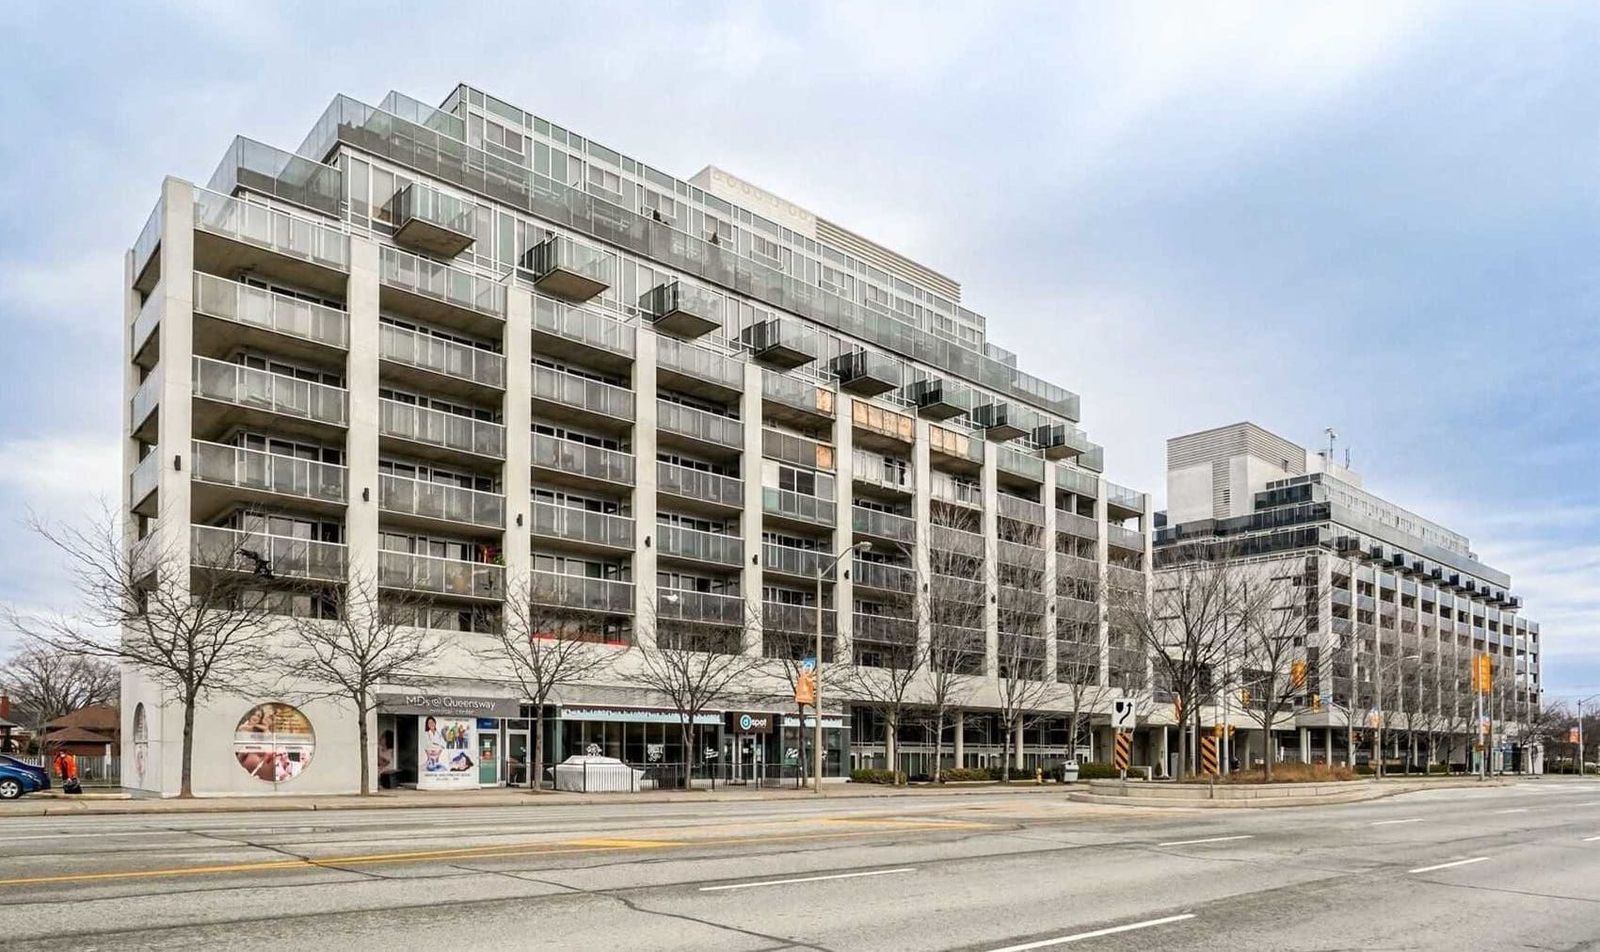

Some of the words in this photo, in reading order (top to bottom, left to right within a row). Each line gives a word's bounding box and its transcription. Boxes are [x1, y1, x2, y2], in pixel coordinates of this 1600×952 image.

[406, 695, 430, 706] MDs
[431, 695, 442, 707] @
[443, 696, 496, 711] Queensway
